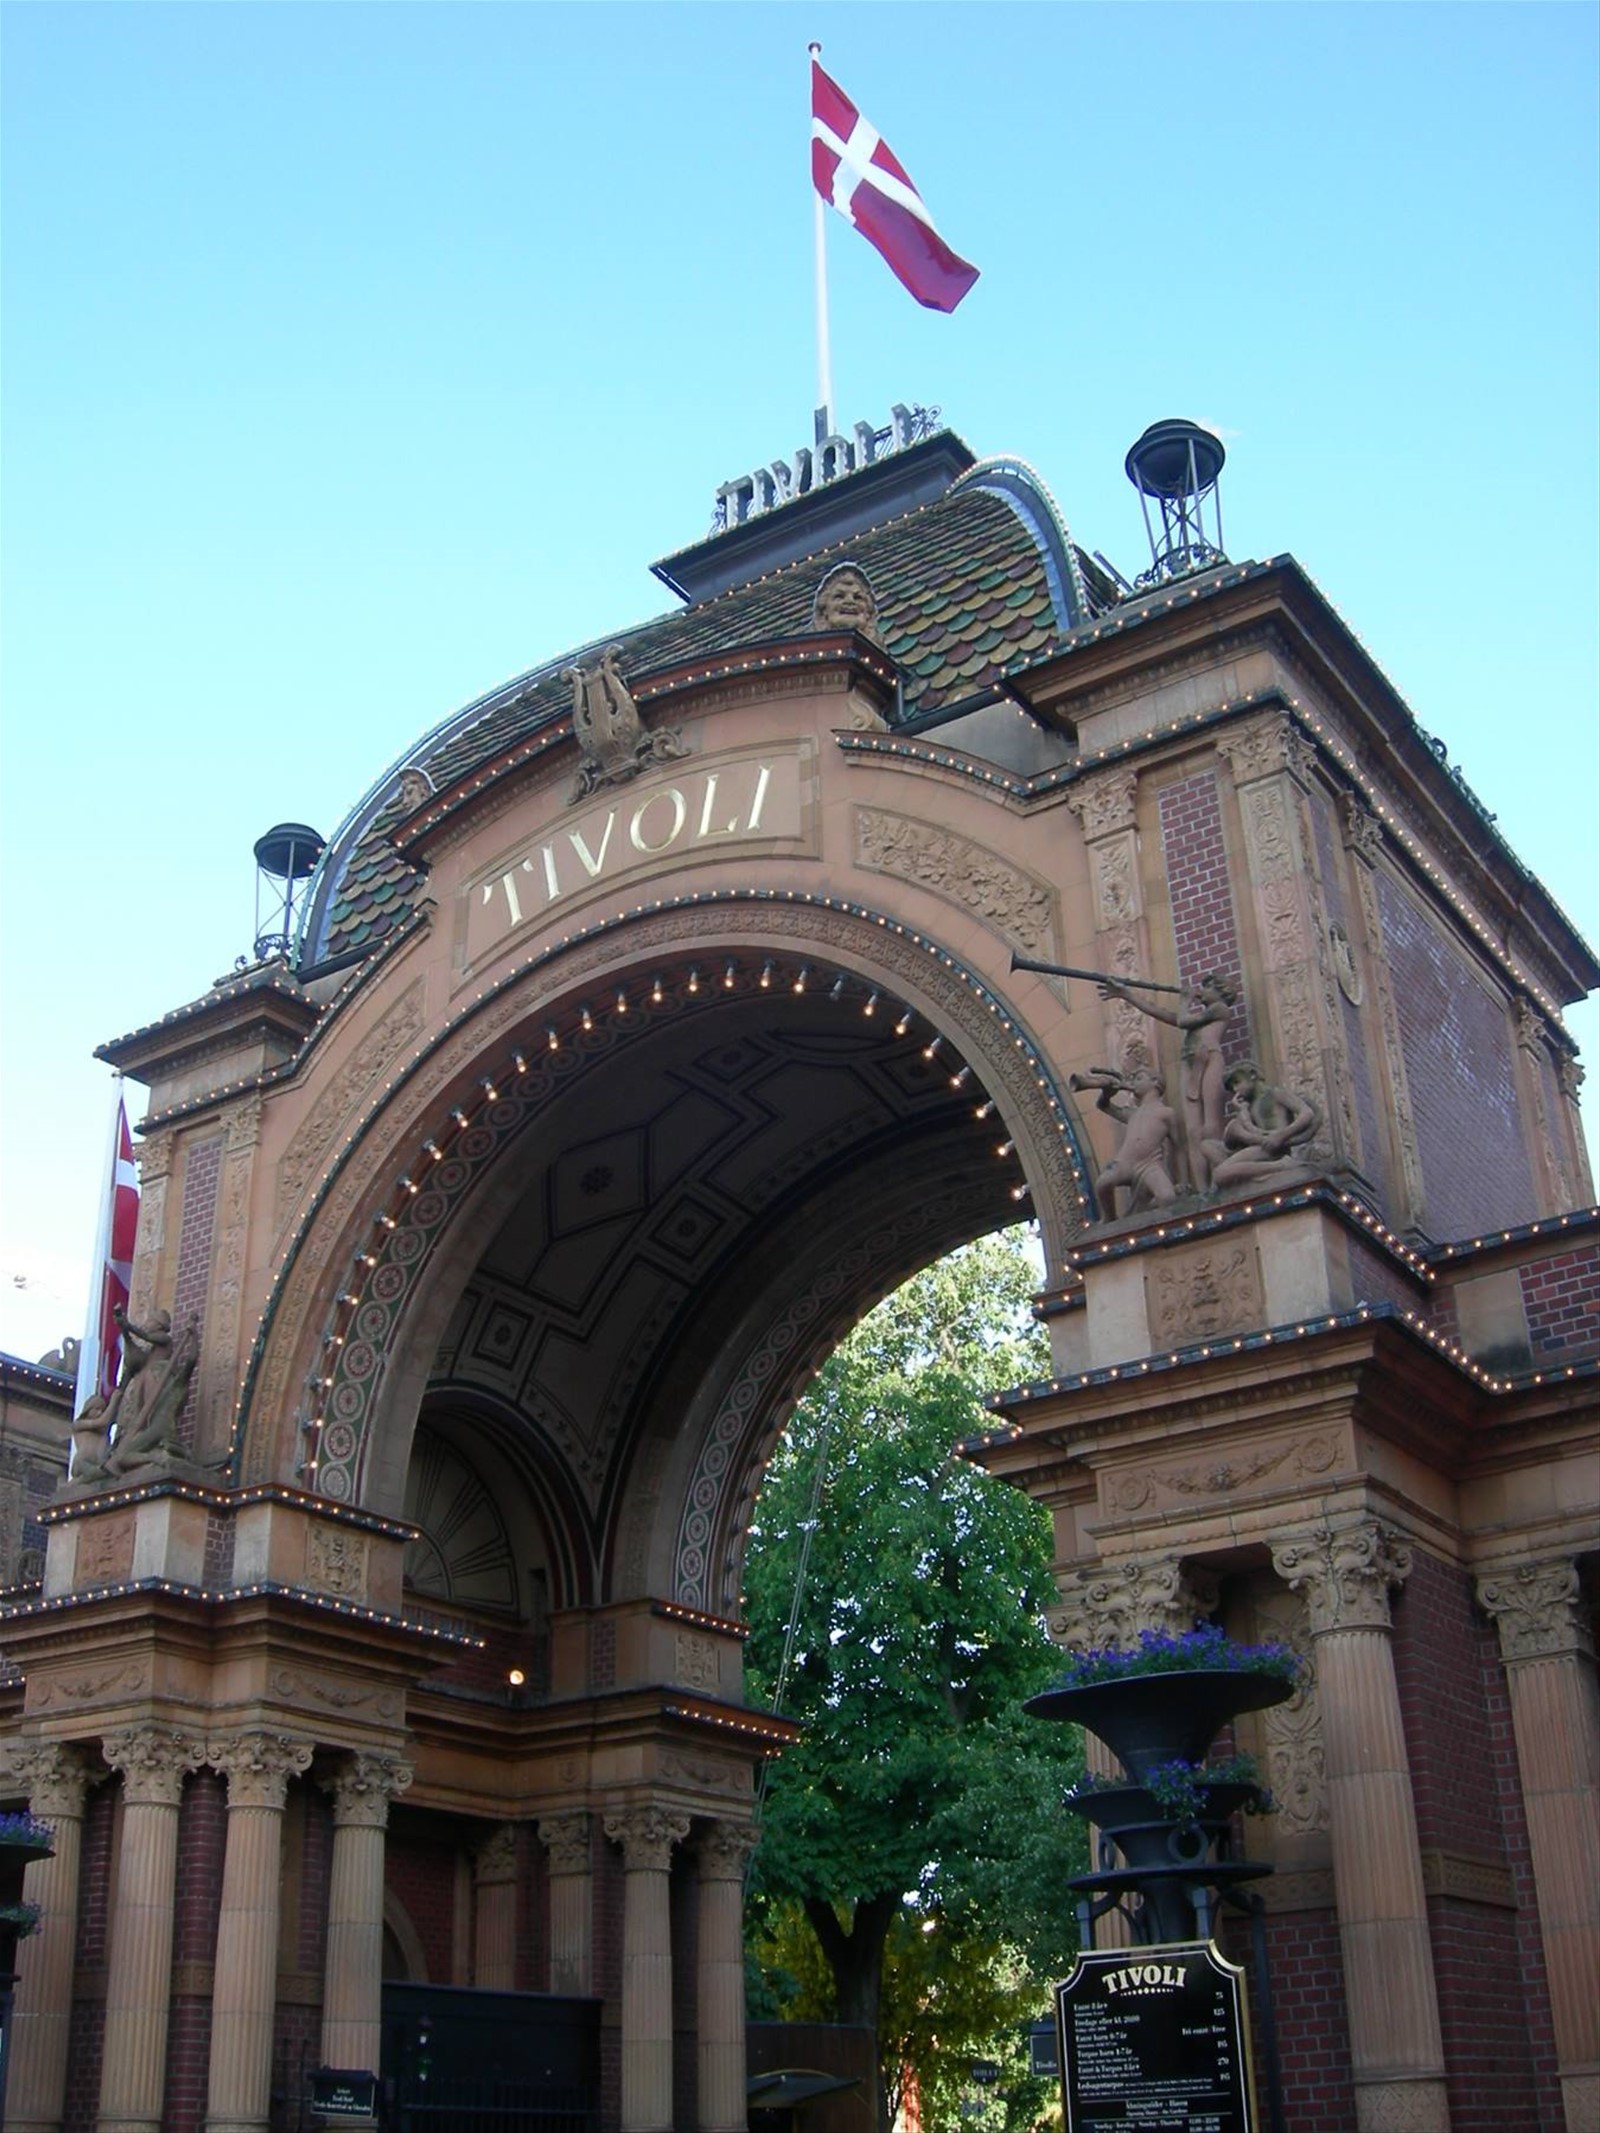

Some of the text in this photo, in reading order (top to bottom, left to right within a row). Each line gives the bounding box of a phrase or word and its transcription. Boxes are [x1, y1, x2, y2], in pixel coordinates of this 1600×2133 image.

[716, 402, 914, 530] TIVOLI
[481, 764, 774, 927] TIVOLI
[1101, 1964, 1187, 1994] TIVOLI
